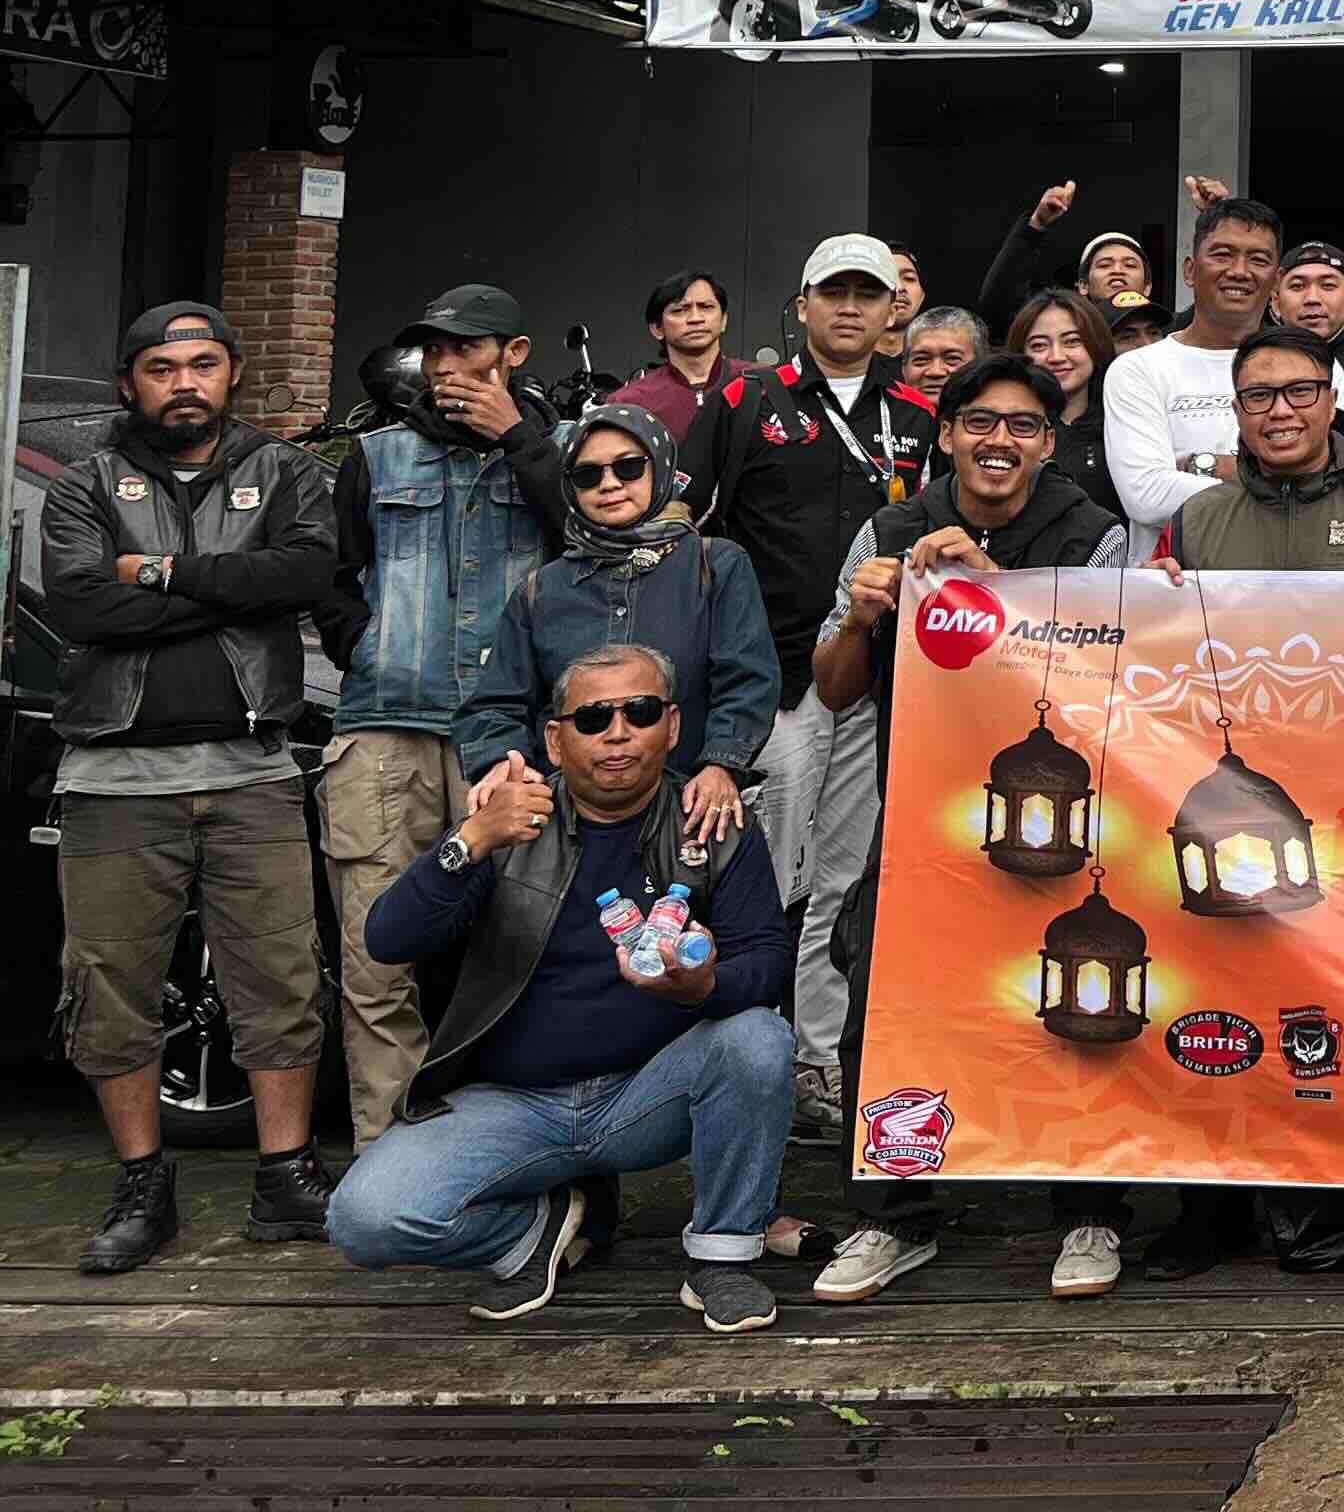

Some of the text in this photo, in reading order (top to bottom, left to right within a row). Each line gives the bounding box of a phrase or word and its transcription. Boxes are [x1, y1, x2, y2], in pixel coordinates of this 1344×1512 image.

[1163, 3, 1236, 34] GEN
[926, 607, 998, 633] DAYA
[1009, 619, 1126, 648] Adicipta
[1000, 640, 1067, 663] Motora
[1171, 1013, 1220, 1034] BRIGADE
[1178, 1035, 1248, 1051] BRITIS
[1177, 1053, 1251, 1076] SUMEDANG
[880, 1135, 939, 1145] HONDA
[876, 1148, 937, 1162] COMMUNITY
